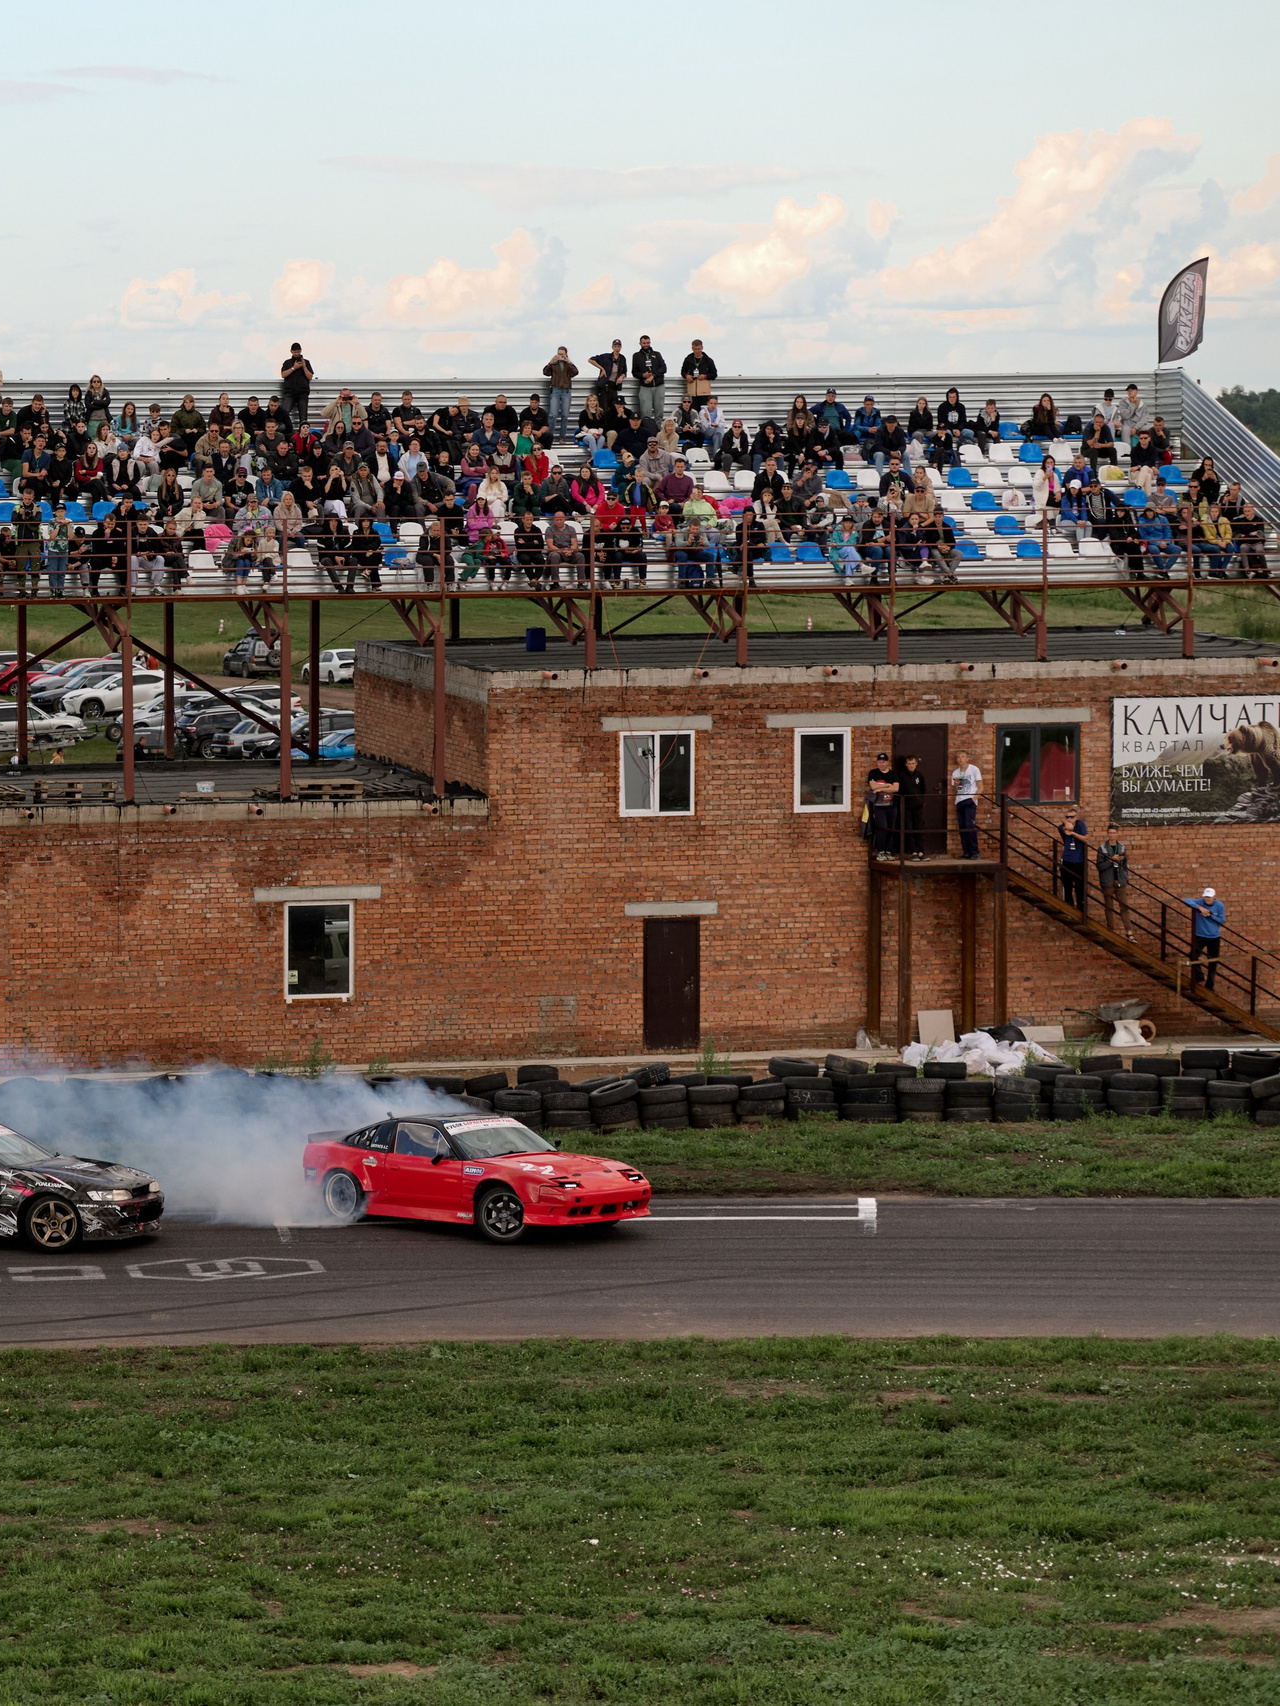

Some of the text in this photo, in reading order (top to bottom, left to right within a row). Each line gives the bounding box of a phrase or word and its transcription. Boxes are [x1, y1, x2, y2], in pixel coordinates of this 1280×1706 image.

[1123, 702, 1280, 736] КАМЧАТ
[1122, 740, 1204, 753] КВАРТАЛ
[1122, 764, 1204, 779] БЛИЖЕ, ЧЕМ
[1122, 779, 1211, 793] ВЫ ДУМАЕТЕ!
